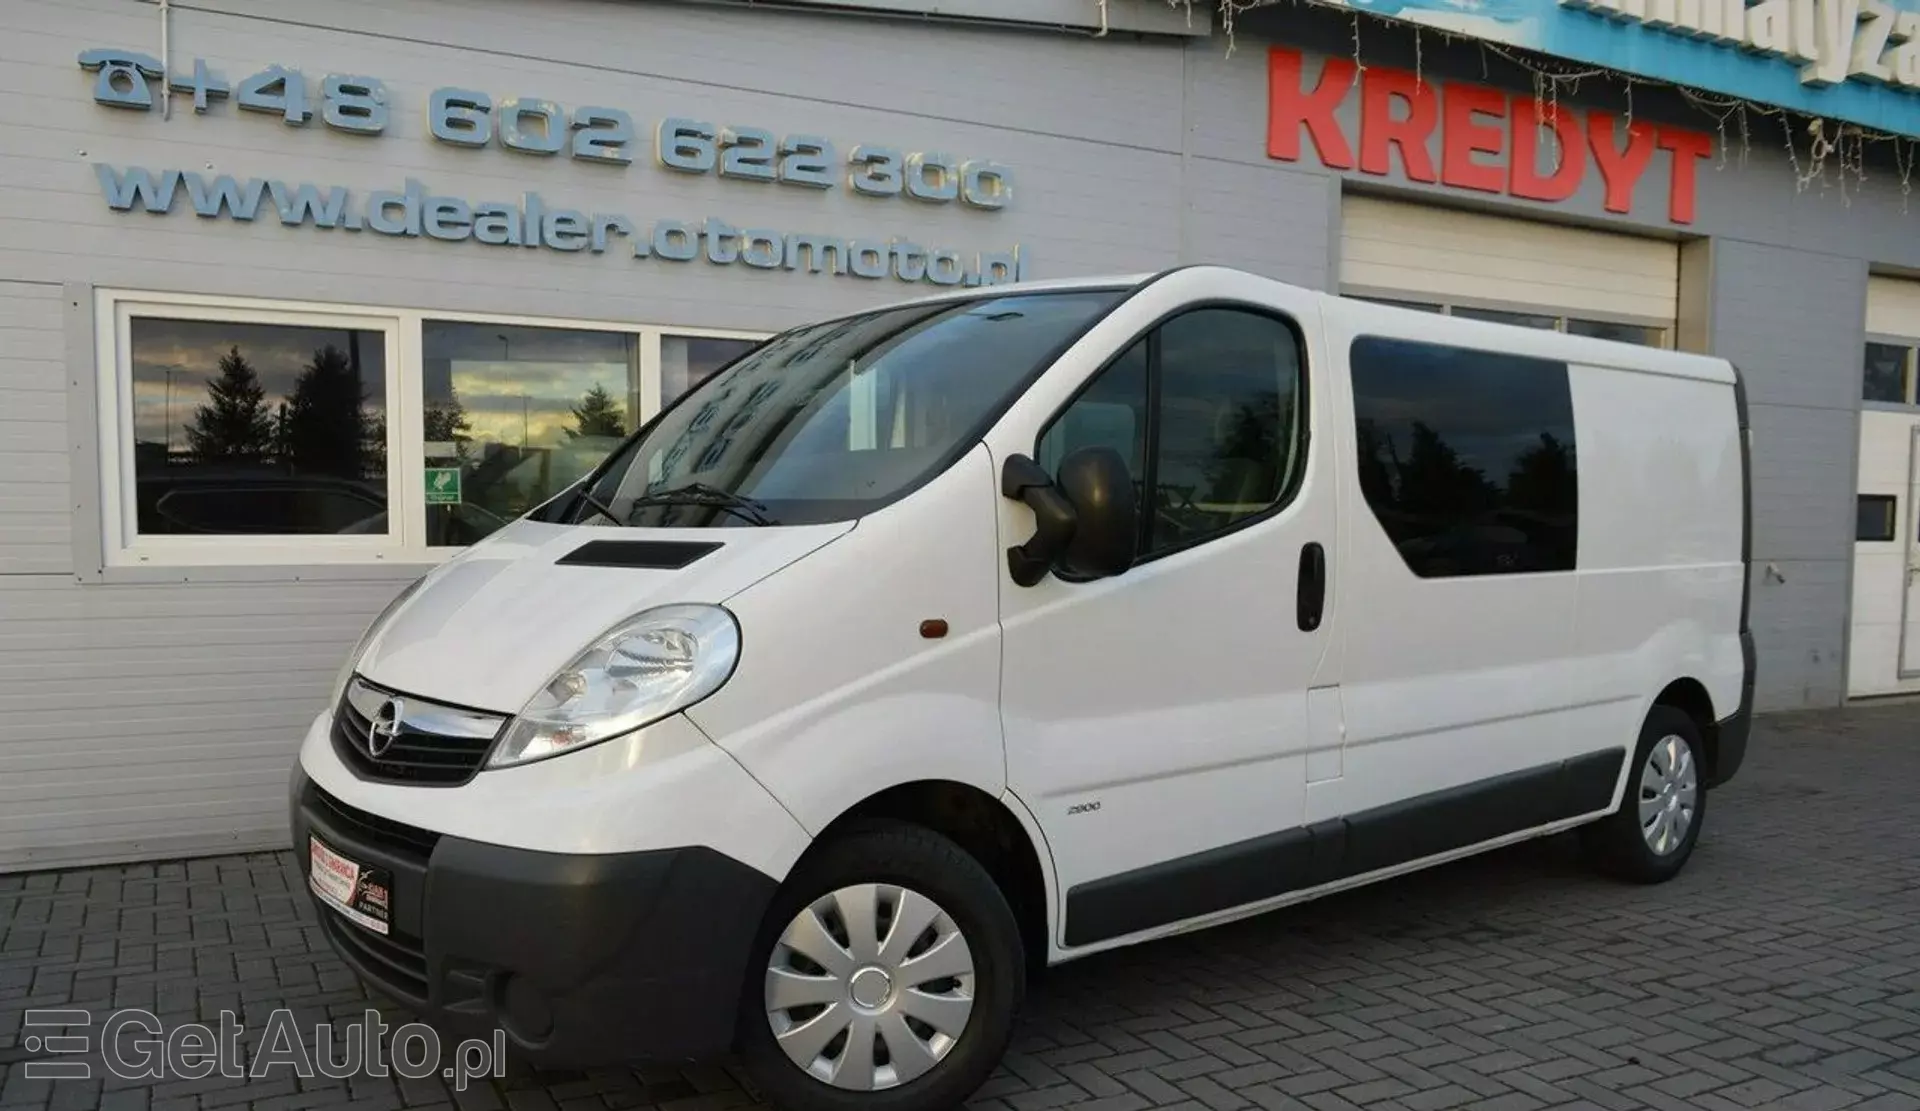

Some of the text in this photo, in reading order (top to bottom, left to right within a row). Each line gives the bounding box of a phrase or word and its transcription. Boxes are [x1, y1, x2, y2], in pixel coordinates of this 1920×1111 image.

[171, 58, 1014, 211] +48 602 622 300
[1266, 46, 1714, 225] KREDYT
[93, 162, 1029, 287] www.dealer.otomoto.pl
